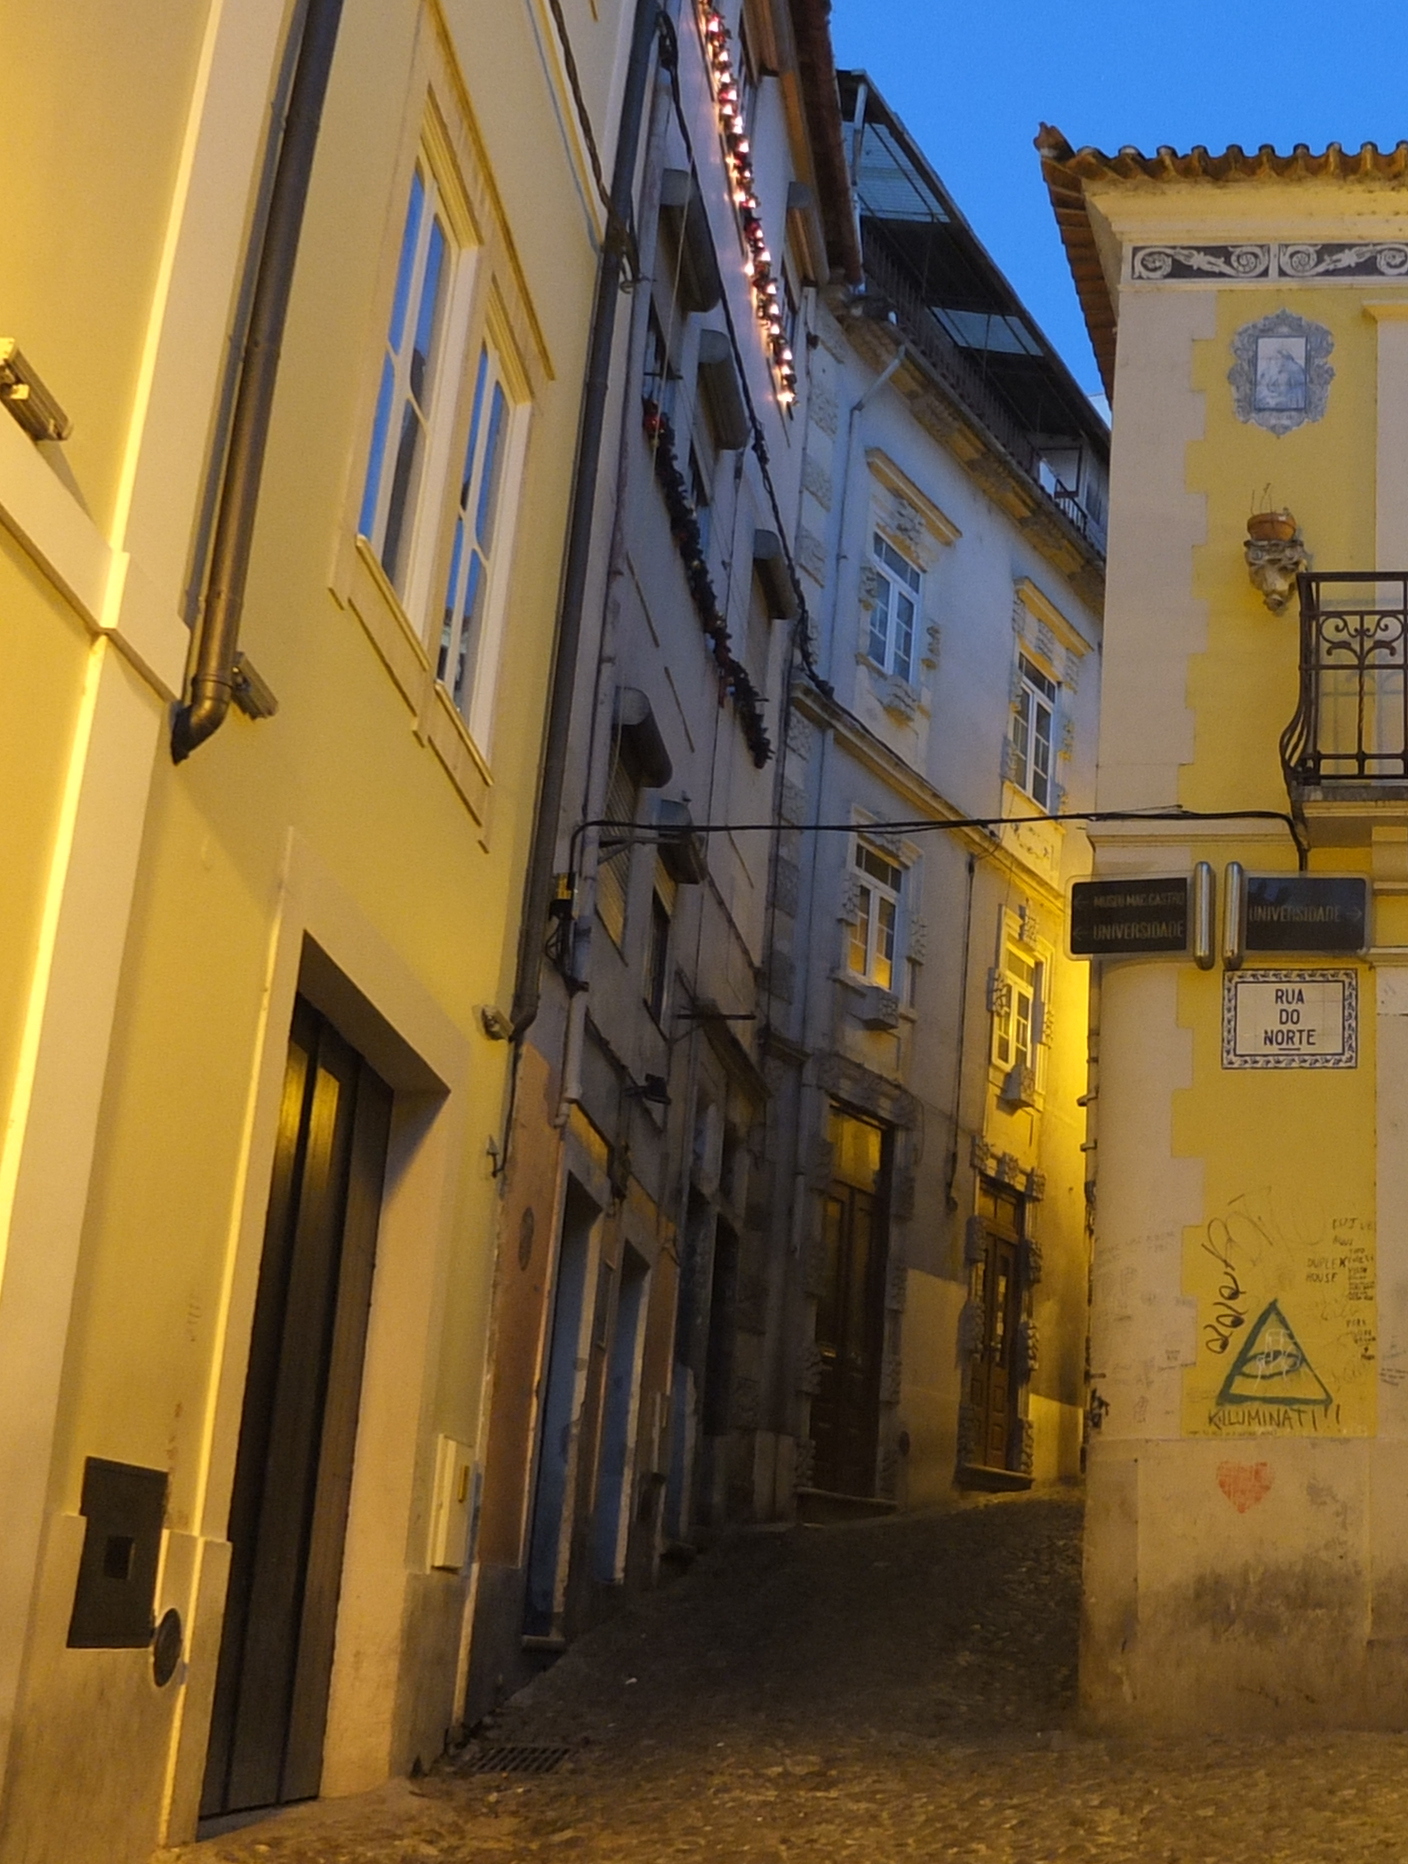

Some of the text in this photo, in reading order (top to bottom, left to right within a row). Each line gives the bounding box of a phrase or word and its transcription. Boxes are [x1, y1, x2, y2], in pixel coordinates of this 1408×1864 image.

[1247, 905, 1341, 922] UNIVERSIDADE
[1093, 921, 1184, 940] UNIVERSIDADE
[1274, 988, 1305, 1005] RUA
[1278, 1008, 1300, 1025] DO
[1263, 1029, 1317, 1046] NORTE
